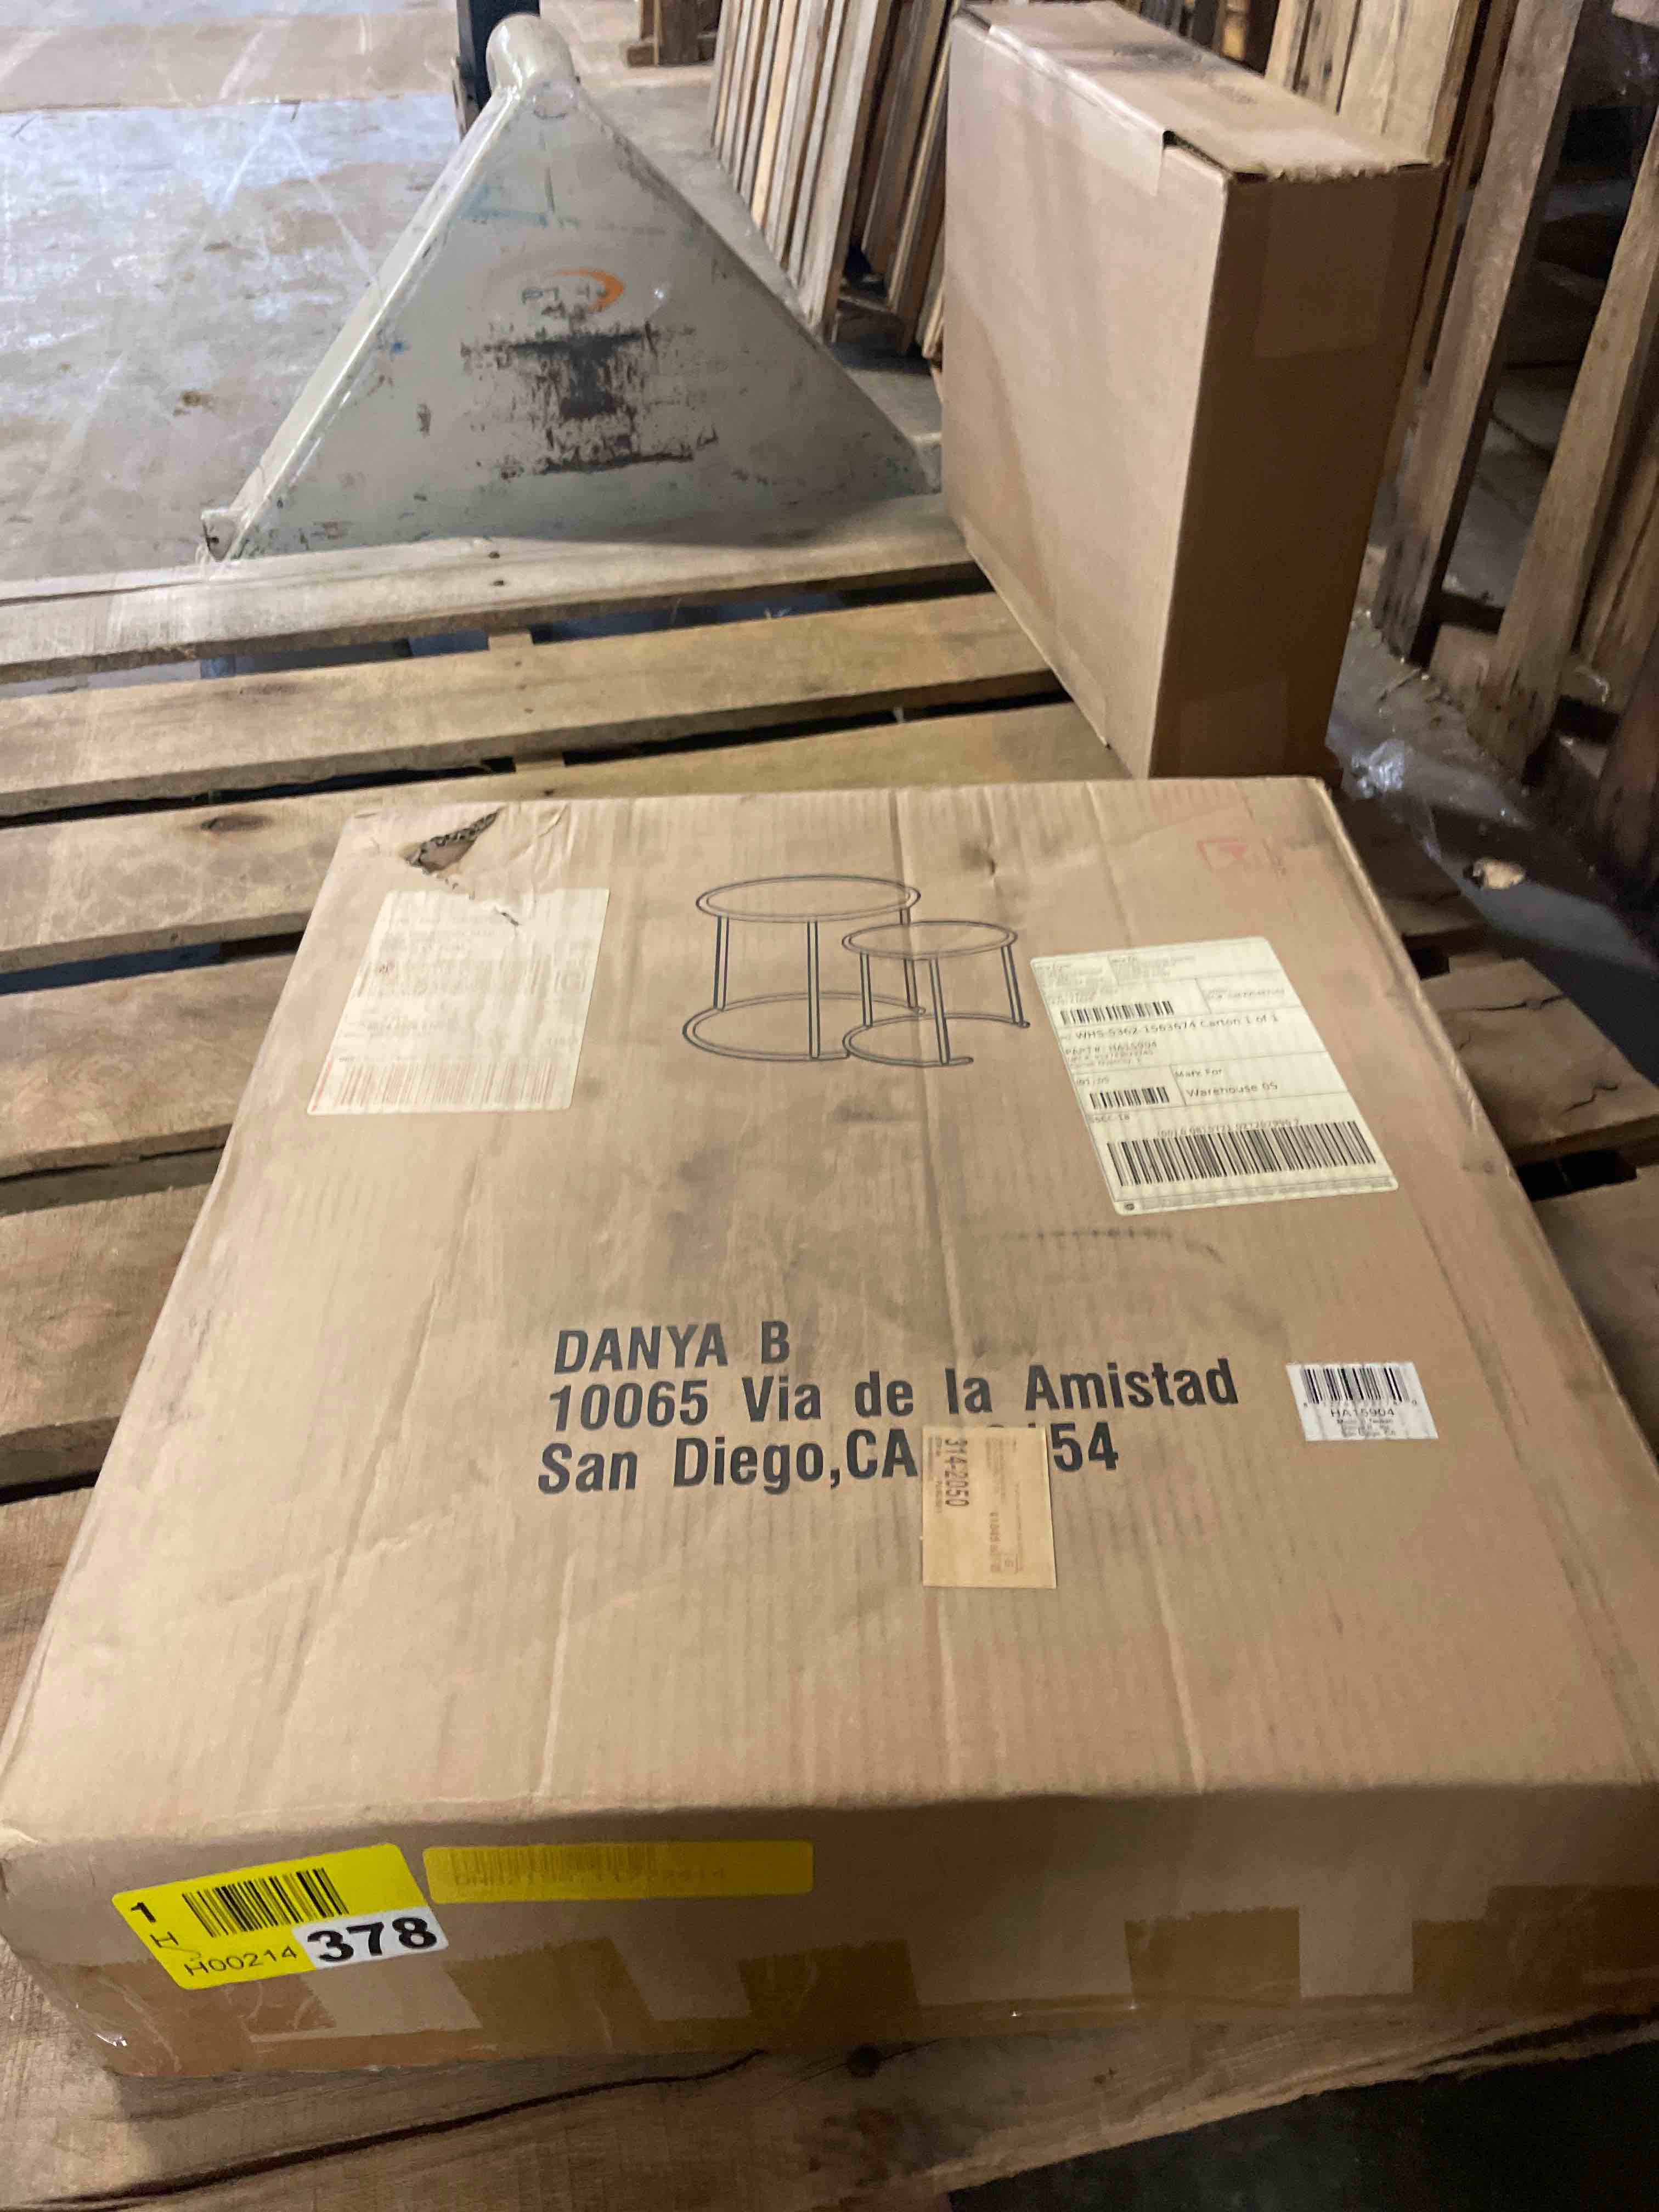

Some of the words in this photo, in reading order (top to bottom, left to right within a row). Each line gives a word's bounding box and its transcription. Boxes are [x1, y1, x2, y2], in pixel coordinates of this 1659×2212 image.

[1186, 1085, 1258, 1098] Warehouse
[554, 1323, 729, 1374] DANYA
[760, 1320, 790, 1364] B
[550, 1379, 709, 1432] 10065
[741, 1375, 822, 1422] Via
[854, 1370, 914, 1418] de
[944, 1367, 993, 1415] la
[1025, 1357, 1239, 1411] Amistad
[537, 1442, 638, 1493] San
[131, 1901, 156, 1923] 1
[183, 1945, 298, 1977] H00214
[307, 1917, 438, 1962] 378
